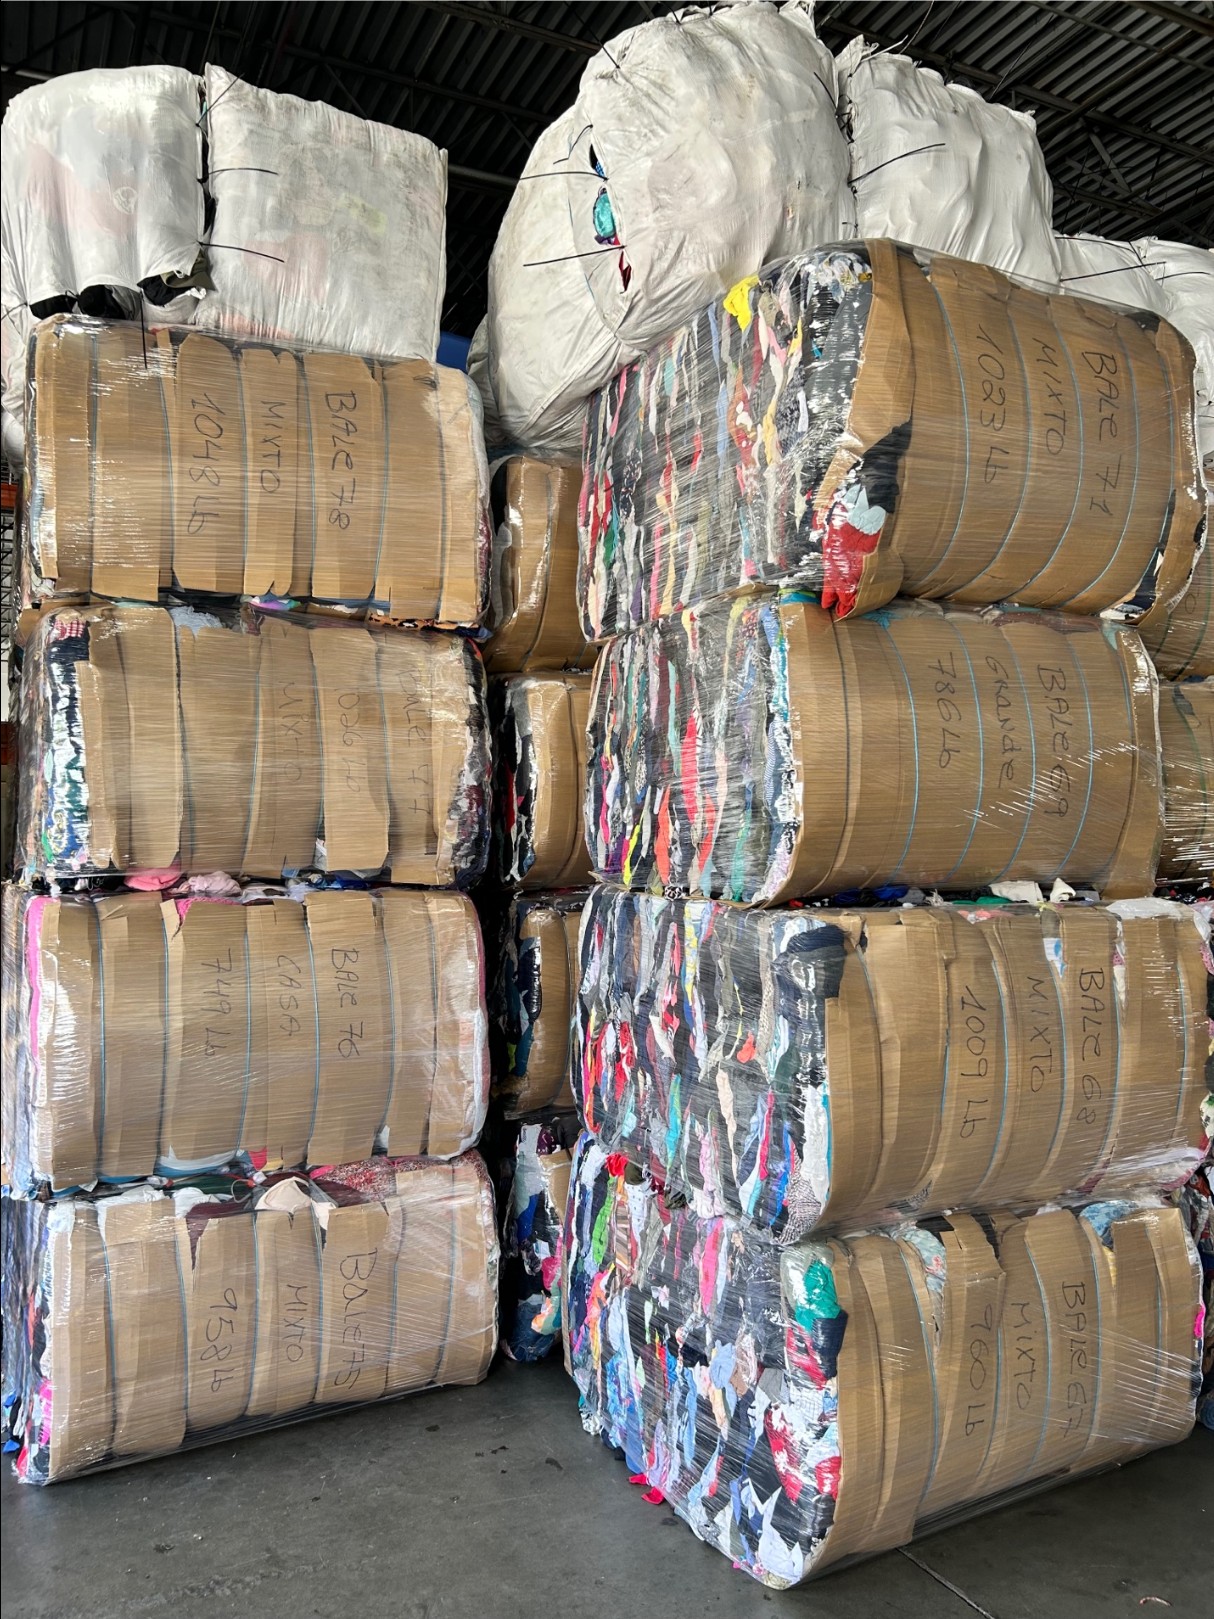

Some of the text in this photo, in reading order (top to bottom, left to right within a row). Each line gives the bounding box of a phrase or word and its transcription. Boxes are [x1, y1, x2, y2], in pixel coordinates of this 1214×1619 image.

[976, 323, 1007, 432] 1023
[1032, 337, 1068, 456] MIXTO
[189, 392, 226, 487] 1048
[260, 400, 287, 493] MIXTO
[328, 477, 356, 530] 78
[1089, 454, 1122, 516] 71
[928, 651, 963, 722] 786
[1043, 763, 1072, 818] 69
[201, 948, 233, 1016] 749
[276, 955, 302, 1036] CASA
[337, 1021, 364, 1059] 76
[960, 985, 988, 1078] 1009
[1026, 976, 1053, 1093] MIXTO
[1075, 1074, 1103, 1125] 68
[281, 1283, 310, 1363] MIXTO
[969, 1303, 994, 1391] 960
[1059, 1381, 1088, 1439] 67
